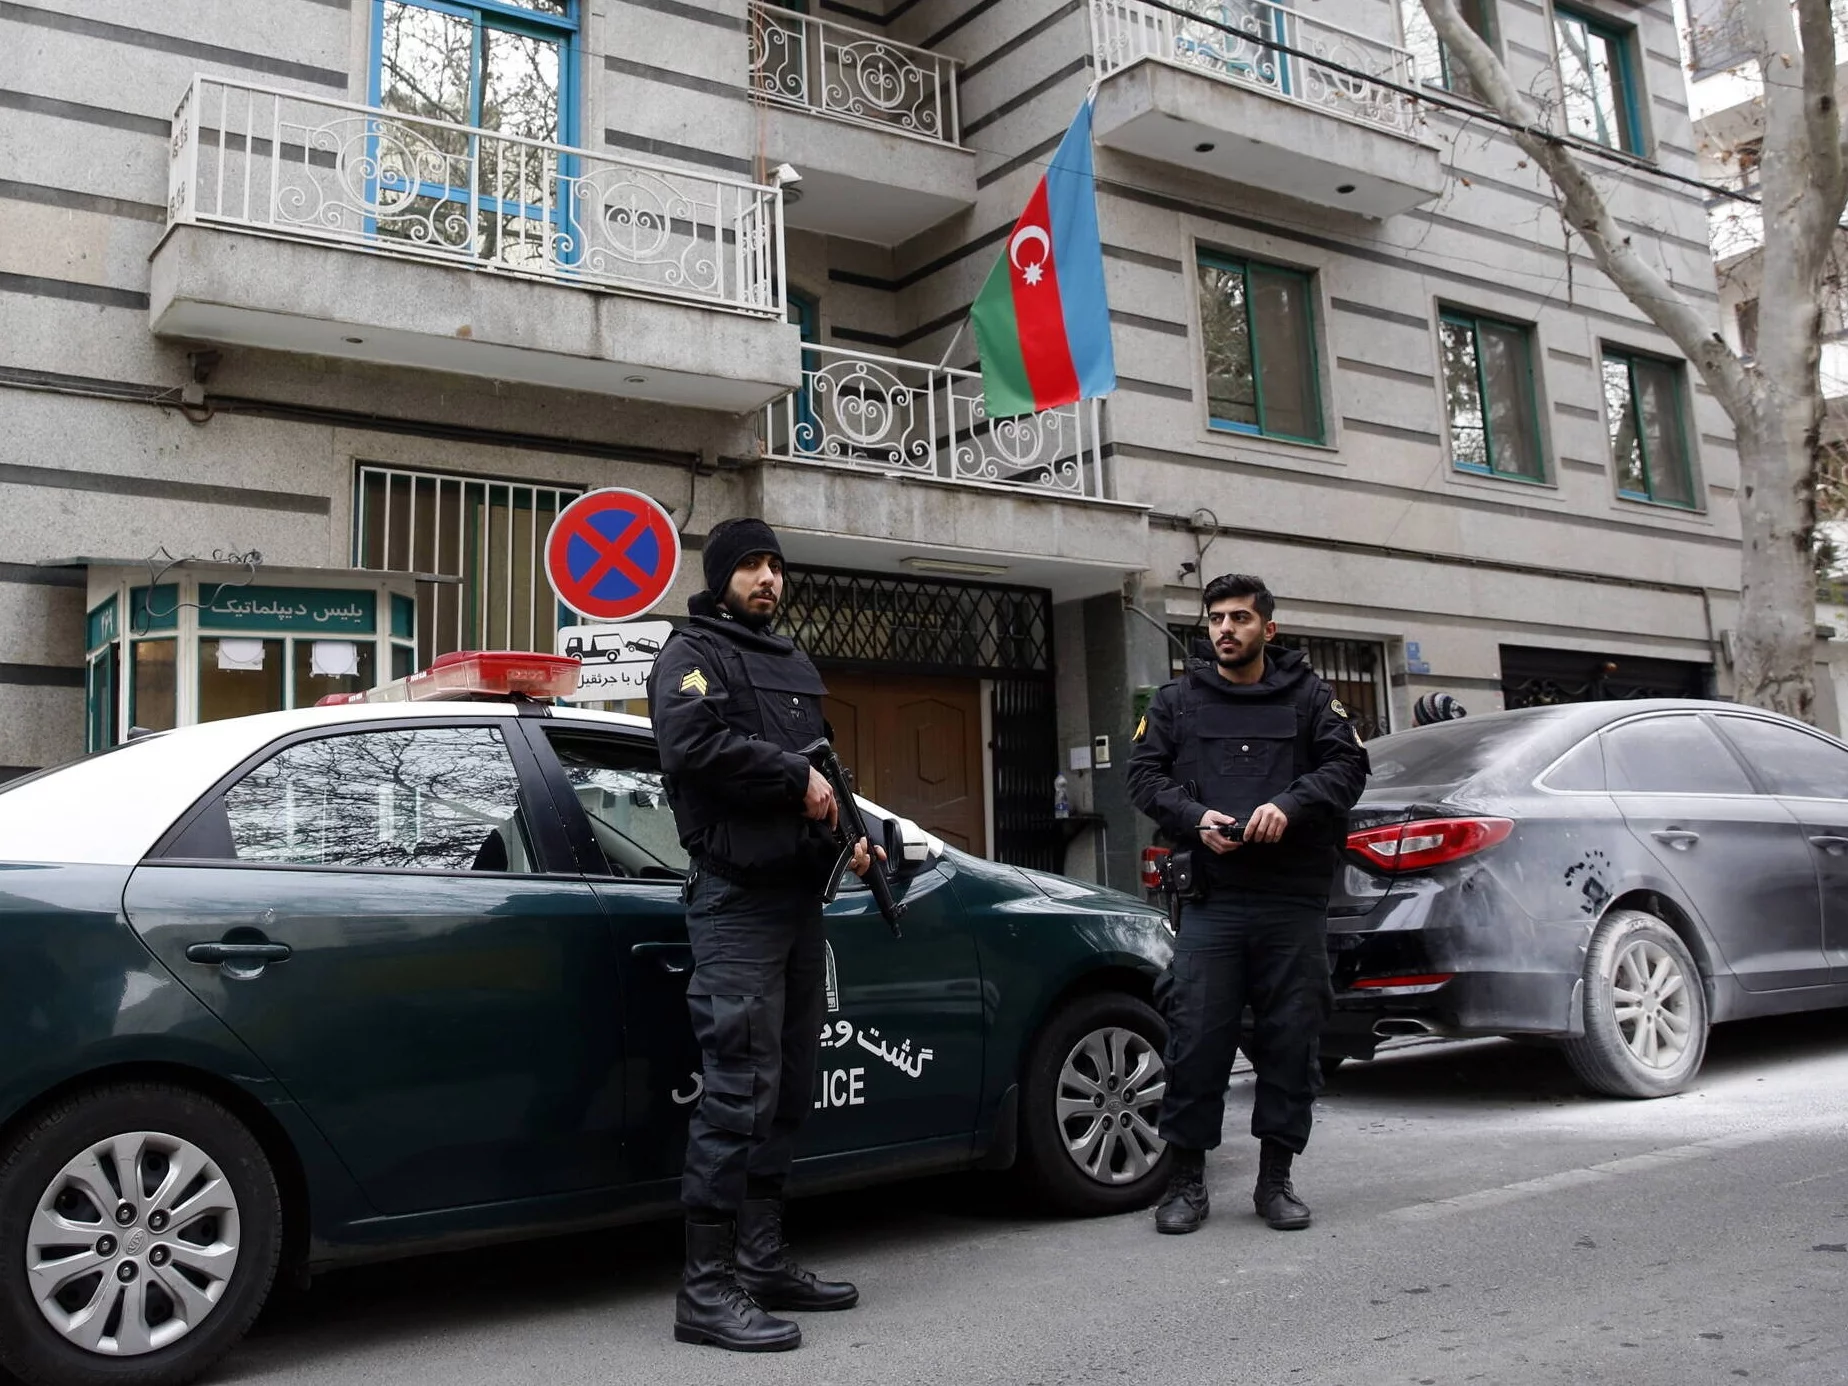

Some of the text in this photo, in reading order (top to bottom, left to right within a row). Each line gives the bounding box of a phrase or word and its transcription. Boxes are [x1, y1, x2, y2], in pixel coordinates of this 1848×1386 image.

[211, 599, 307, 620] دیپلماتیک
[577, 673, 618, 689] جرثقیل
[621, 672, 630, 686] با
[856, 1027, 934, 1078] گشت
